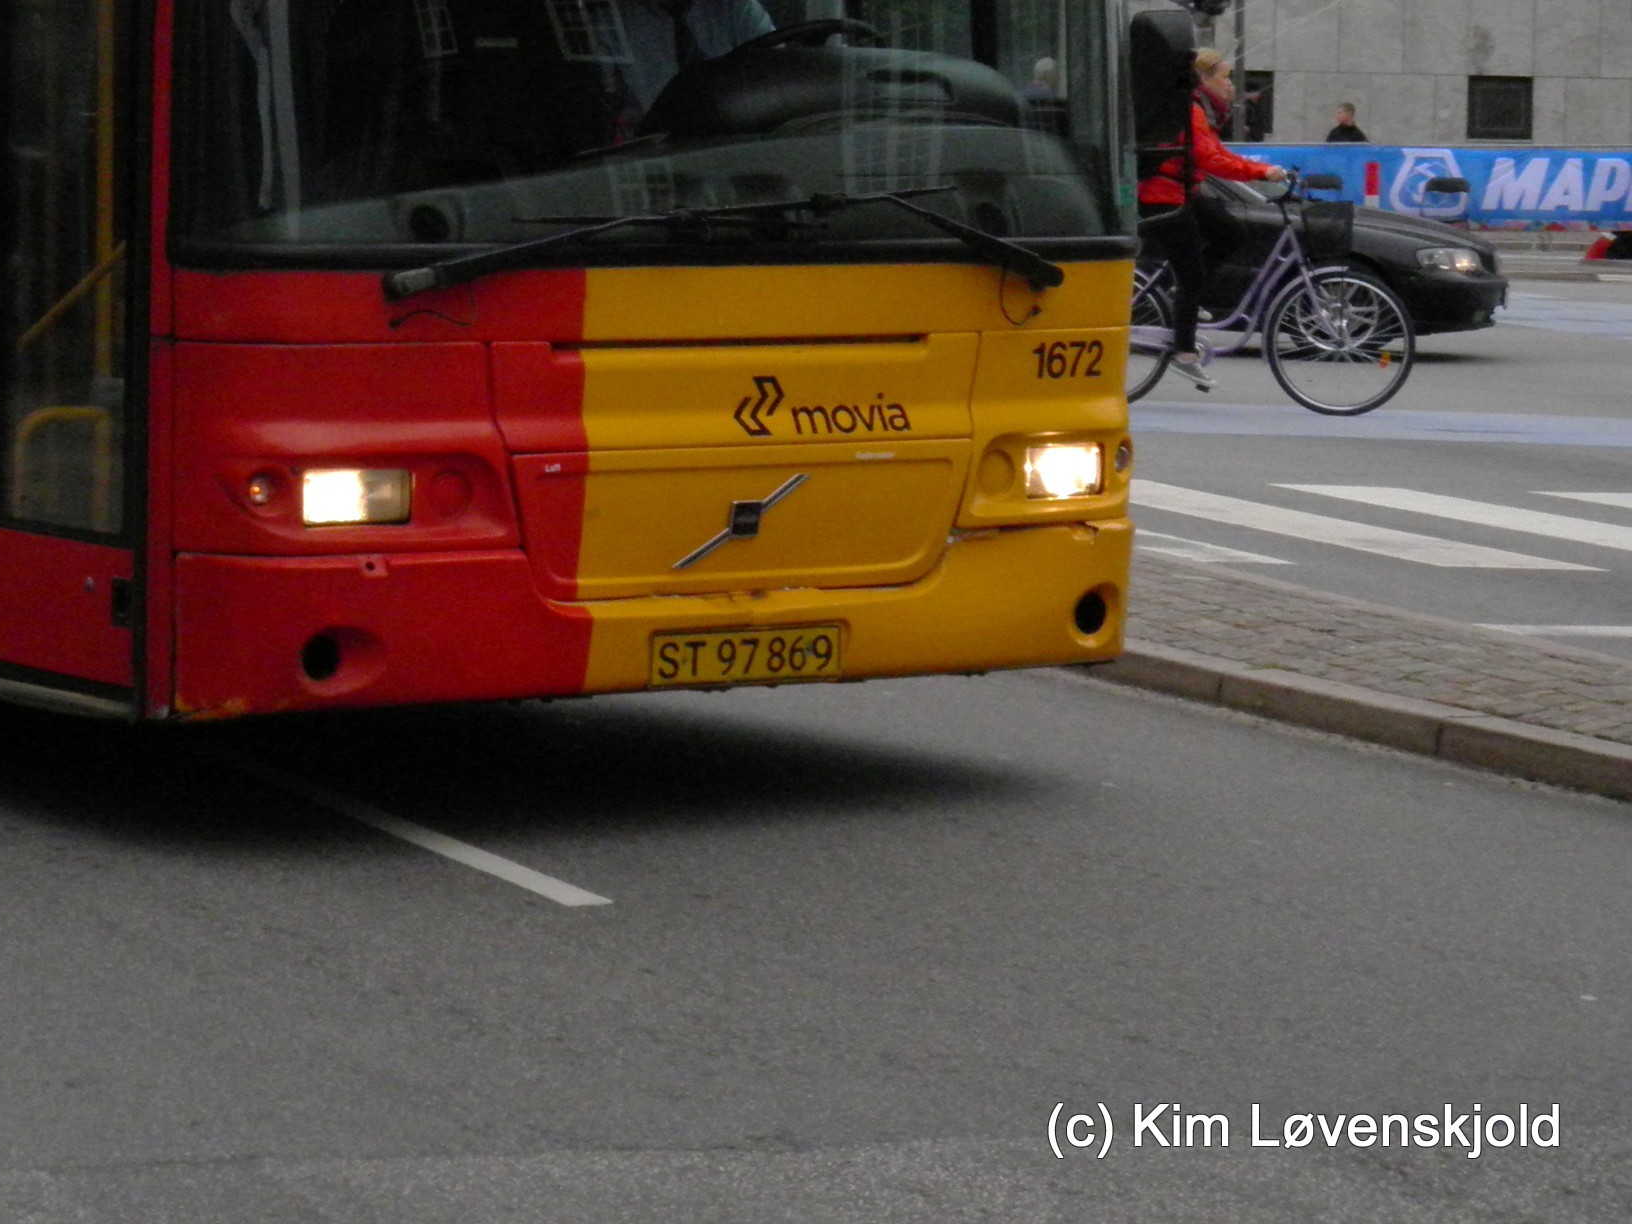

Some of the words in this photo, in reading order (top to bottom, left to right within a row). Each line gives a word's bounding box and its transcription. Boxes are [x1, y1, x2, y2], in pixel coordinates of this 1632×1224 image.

[1481, 156, 1632, 212] MAP
[1033, 340, 1104, 380] 1672
[791, 392, 911, 436] movia
[657, 640, 707, 680] ST
